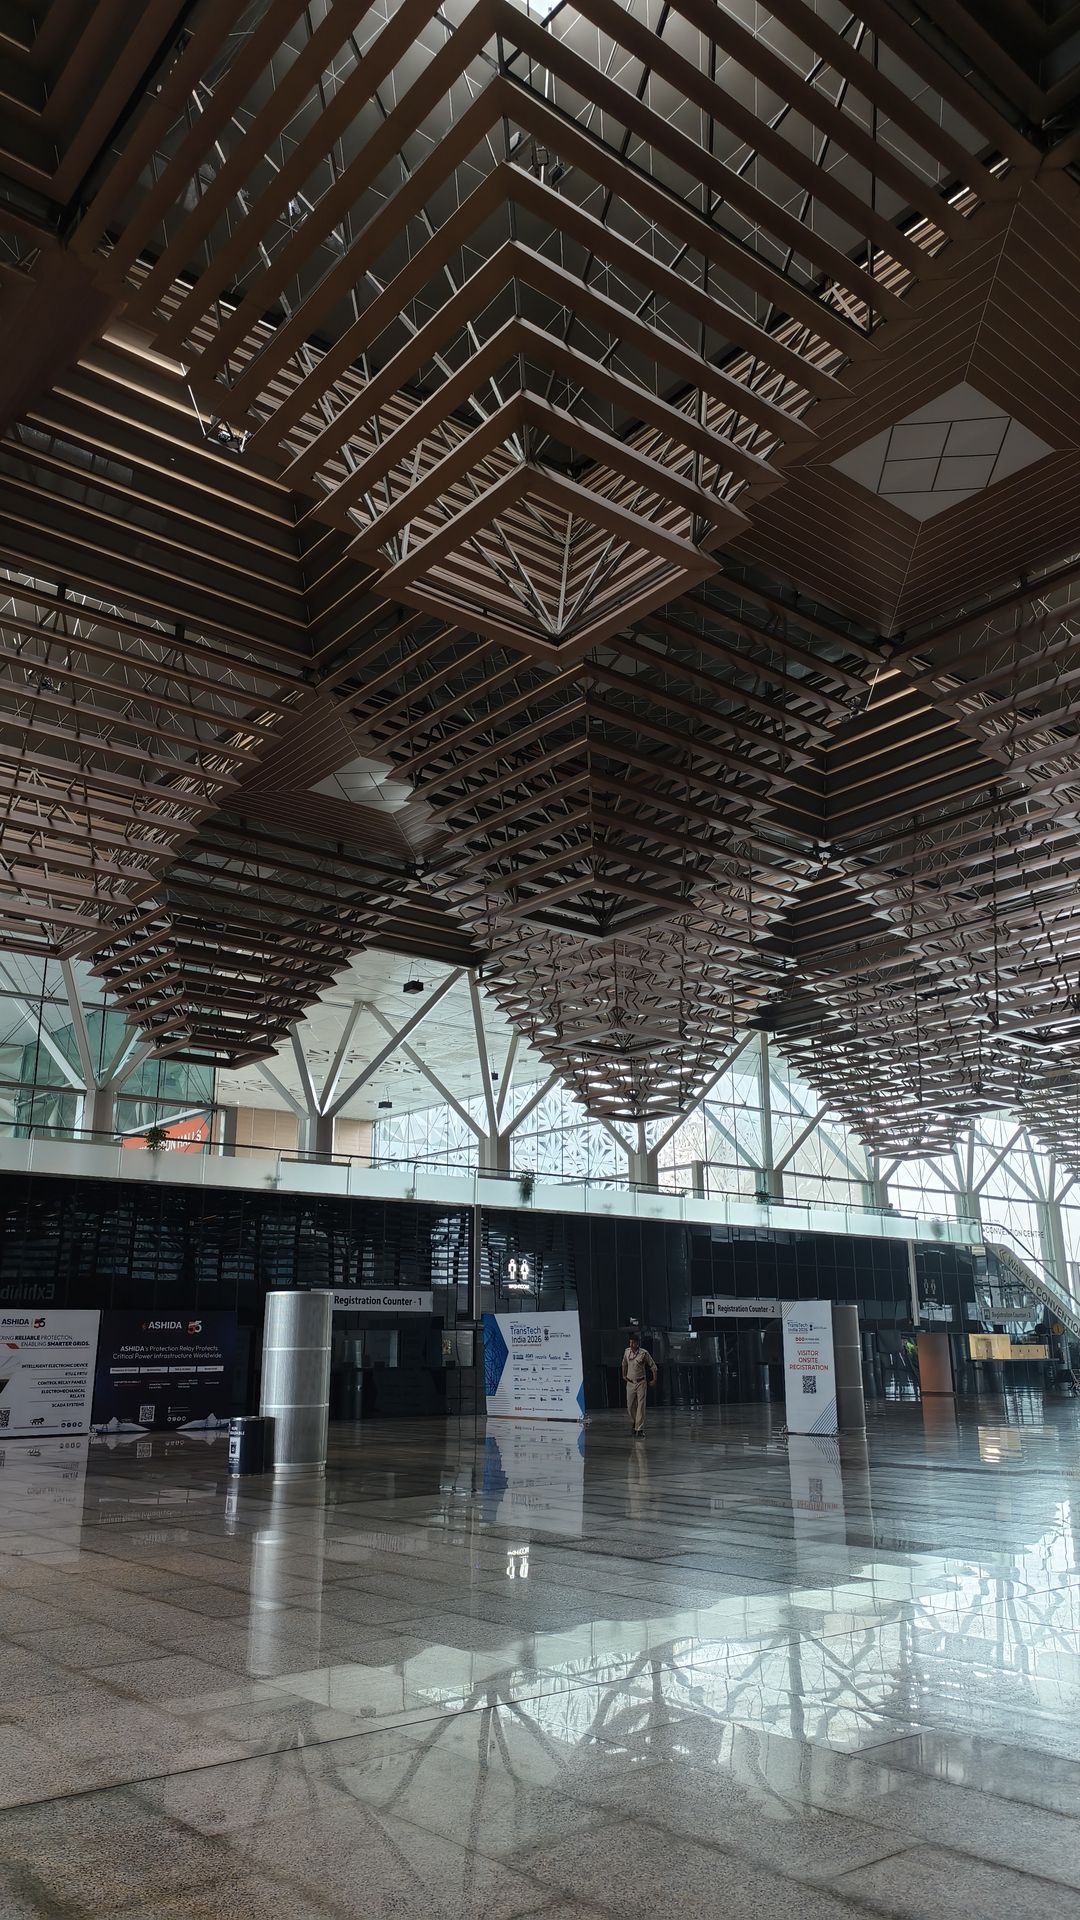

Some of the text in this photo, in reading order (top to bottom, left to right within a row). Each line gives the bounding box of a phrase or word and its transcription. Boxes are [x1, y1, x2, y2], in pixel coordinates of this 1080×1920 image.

[985, 1226, 1023, 1237] CONVEION
[334, 1296, 381, 1306] Registration
[383, 1296, 412, 1306] Counter
[418, 1298, 422, 1306] 1
[1008, 1257, 1080, 1336] WAY TO CONVENTIO
[717, 1304, 749, 1313] Registration
[749, 1305, 768, 1313] Counter
[148, 1321, 182, 1329] ASHIDA
[510, 1326, 542, 1335] TransTech
[512, 1336, 527, 1344] India
[180, 1345, 195, 1353] Relay
